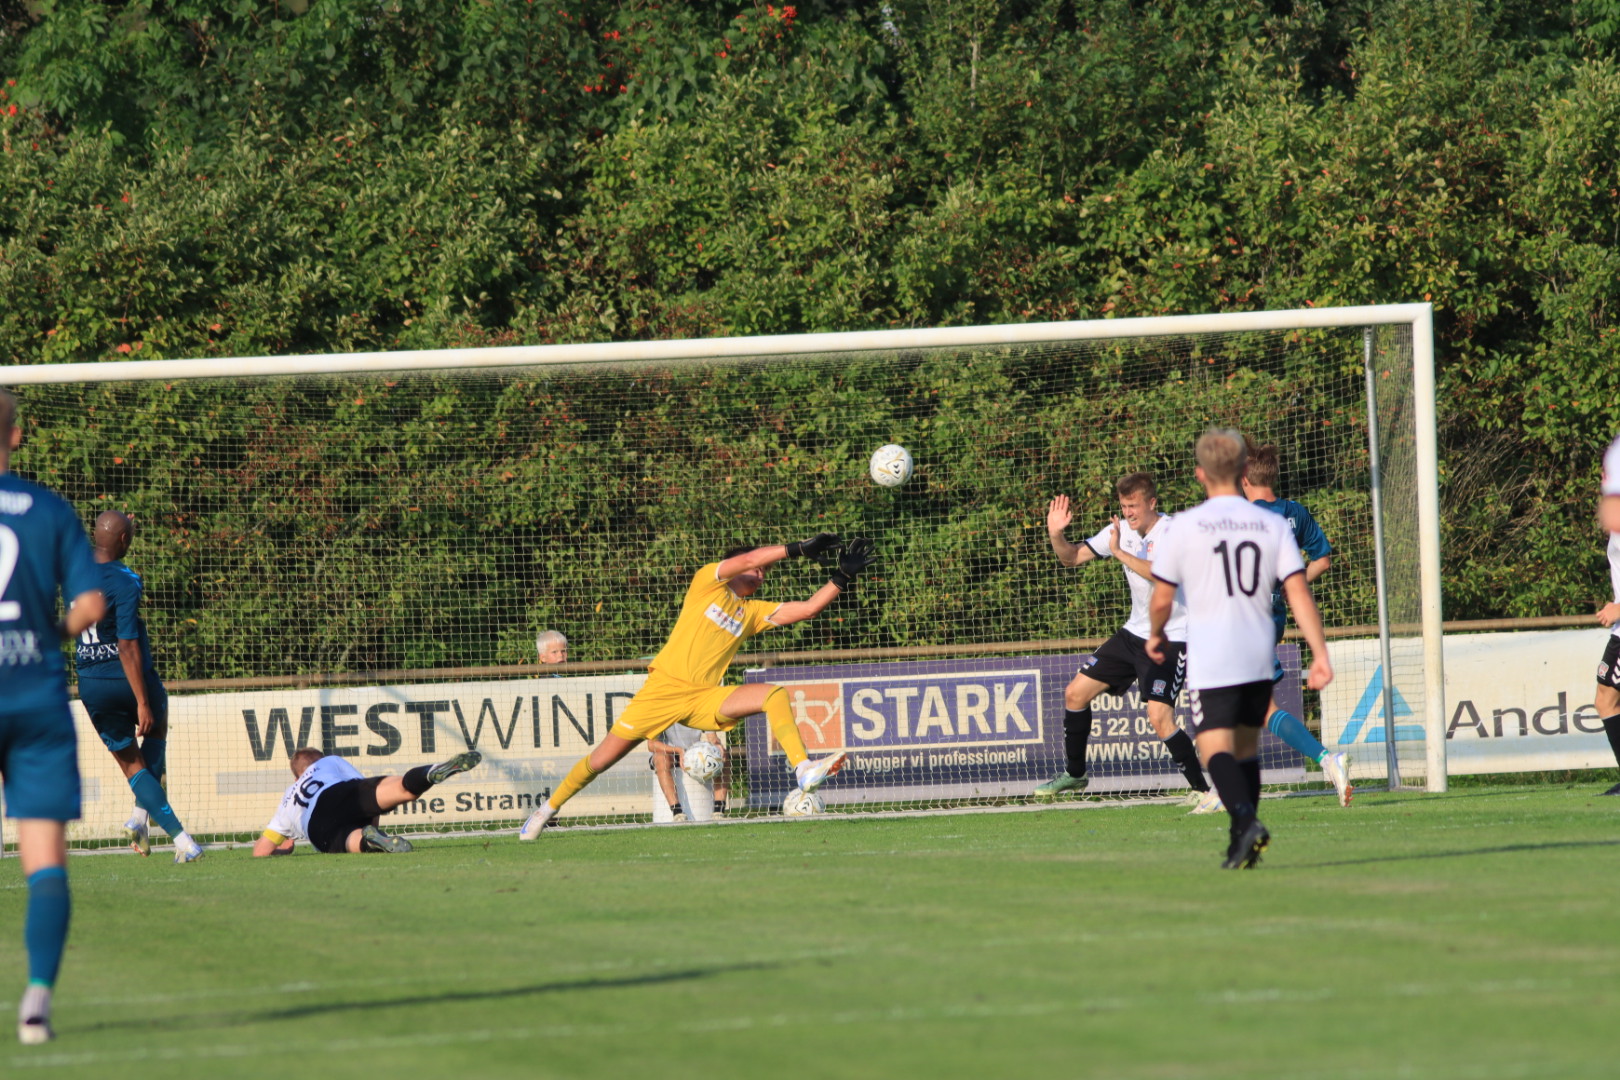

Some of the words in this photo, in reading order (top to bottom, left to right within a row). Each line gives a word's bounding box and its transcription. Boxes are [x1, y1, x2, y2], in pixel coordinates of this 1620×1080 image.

[1198, 517, 1269, 534] Sydbank
[1213, 540, 1262, 597] 10
[852, 682, 1032, 741] STARK
[1090, 692, 1123, 711] 800
[1446, 691, 1606, 739] Ande
[1107, 717, 1130, 736] 22
[855, 754, 907, 774] bygger
[911, 751, 924, 768] vi
[929, 747, 1027, 770] professionelt
[294, 776, 325, 809] 16
[455, 787, 550, 812] Strand
